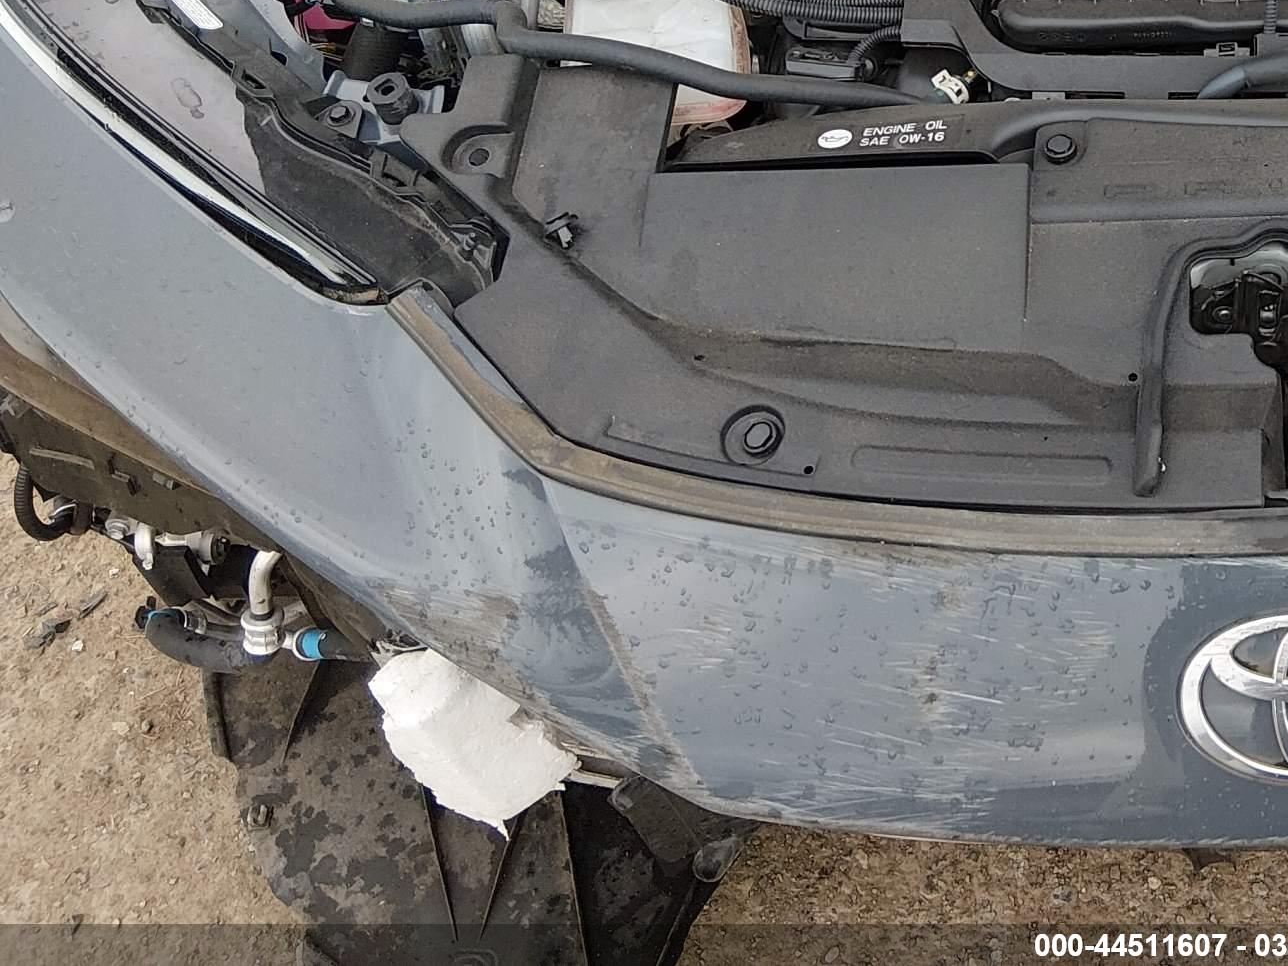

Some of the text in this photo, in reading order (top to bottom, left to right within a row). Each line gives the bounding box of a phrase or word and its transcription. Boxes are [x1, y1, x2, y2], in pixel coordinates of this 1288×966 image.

[863, 120, 947, 137] ENGINE OIL
[859, 136, 890, 147] SAE
